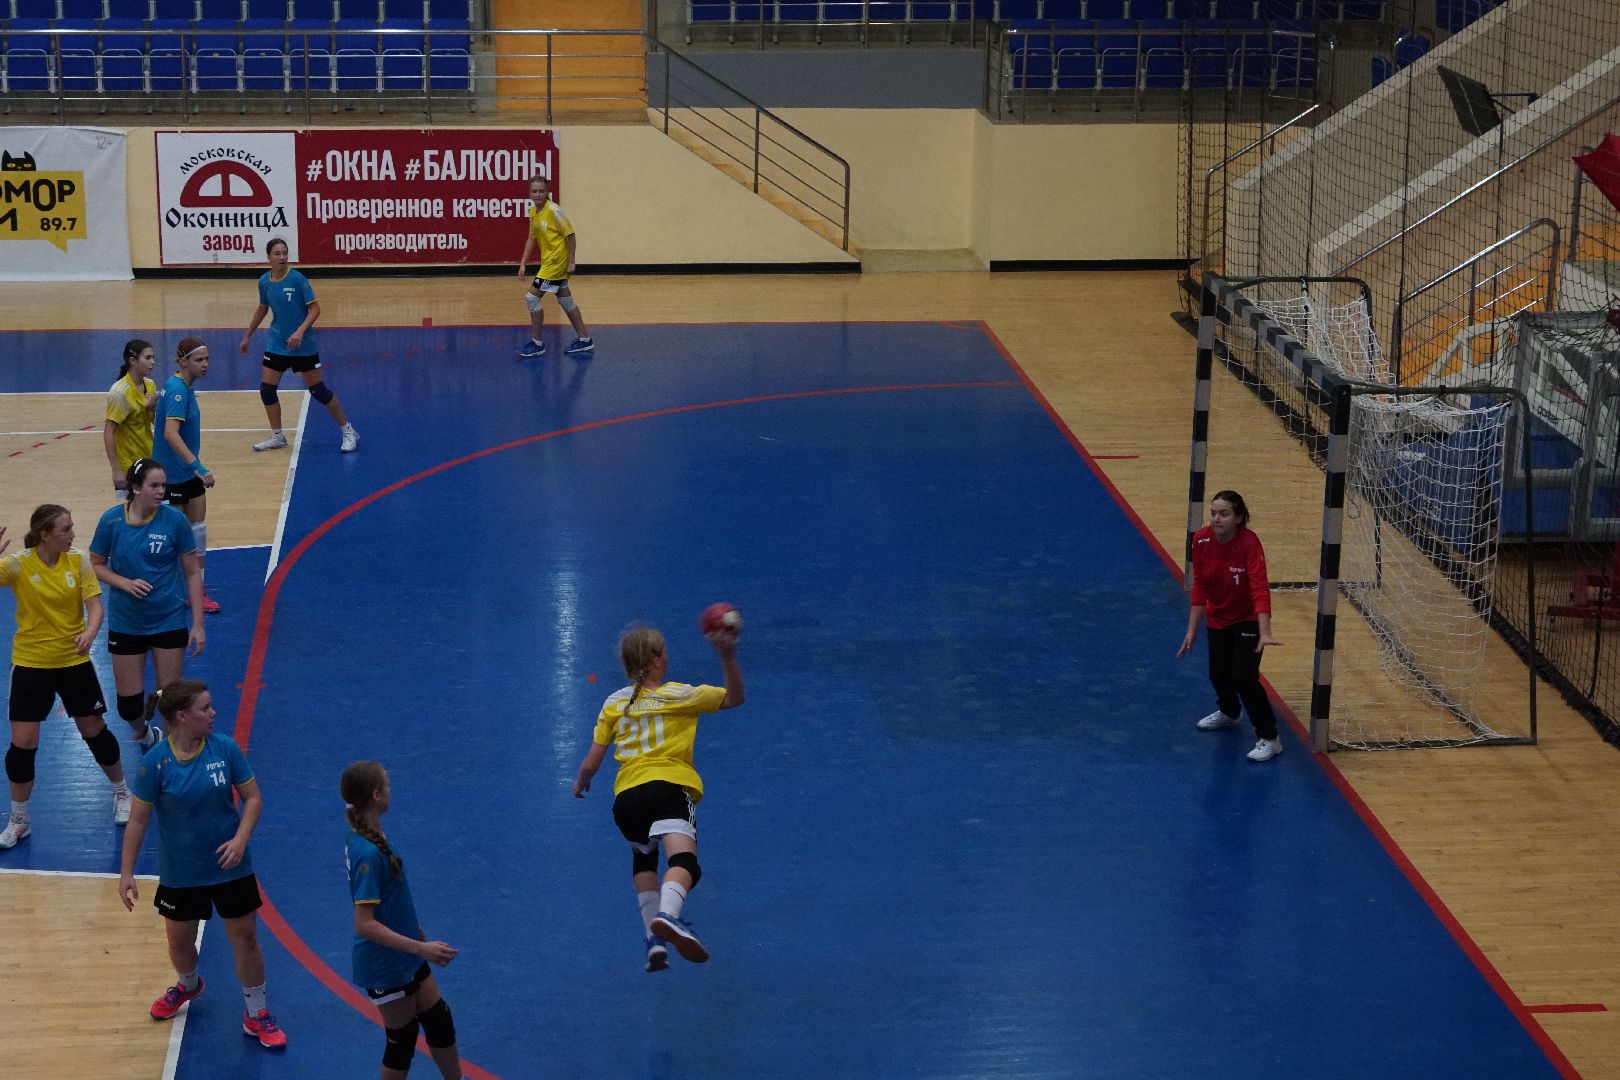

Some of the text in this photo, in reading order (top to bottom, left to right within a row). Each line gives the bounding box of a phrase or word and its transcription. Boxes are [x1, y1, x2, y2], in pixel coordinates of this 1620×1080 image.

[95, 136, 113, 150] 12+
[306, 149, 552, 181] #ОКНА #БАЛКОНЫ
[0, 179, 76, 212] МОР
[306, 192, 444, 224] Проверенное
[40, 217, 78, 231] 89.7
[335, 233, 468, 254] производитель
[286, 292, 292, 302] 7
[149, 541, 163, 554] 17
[65, 571, 76, 588] 6
[1233, 574, 1240, 585] 1
[618, 714, 664, 757] 20
[209, 770, 226, 787] 14
